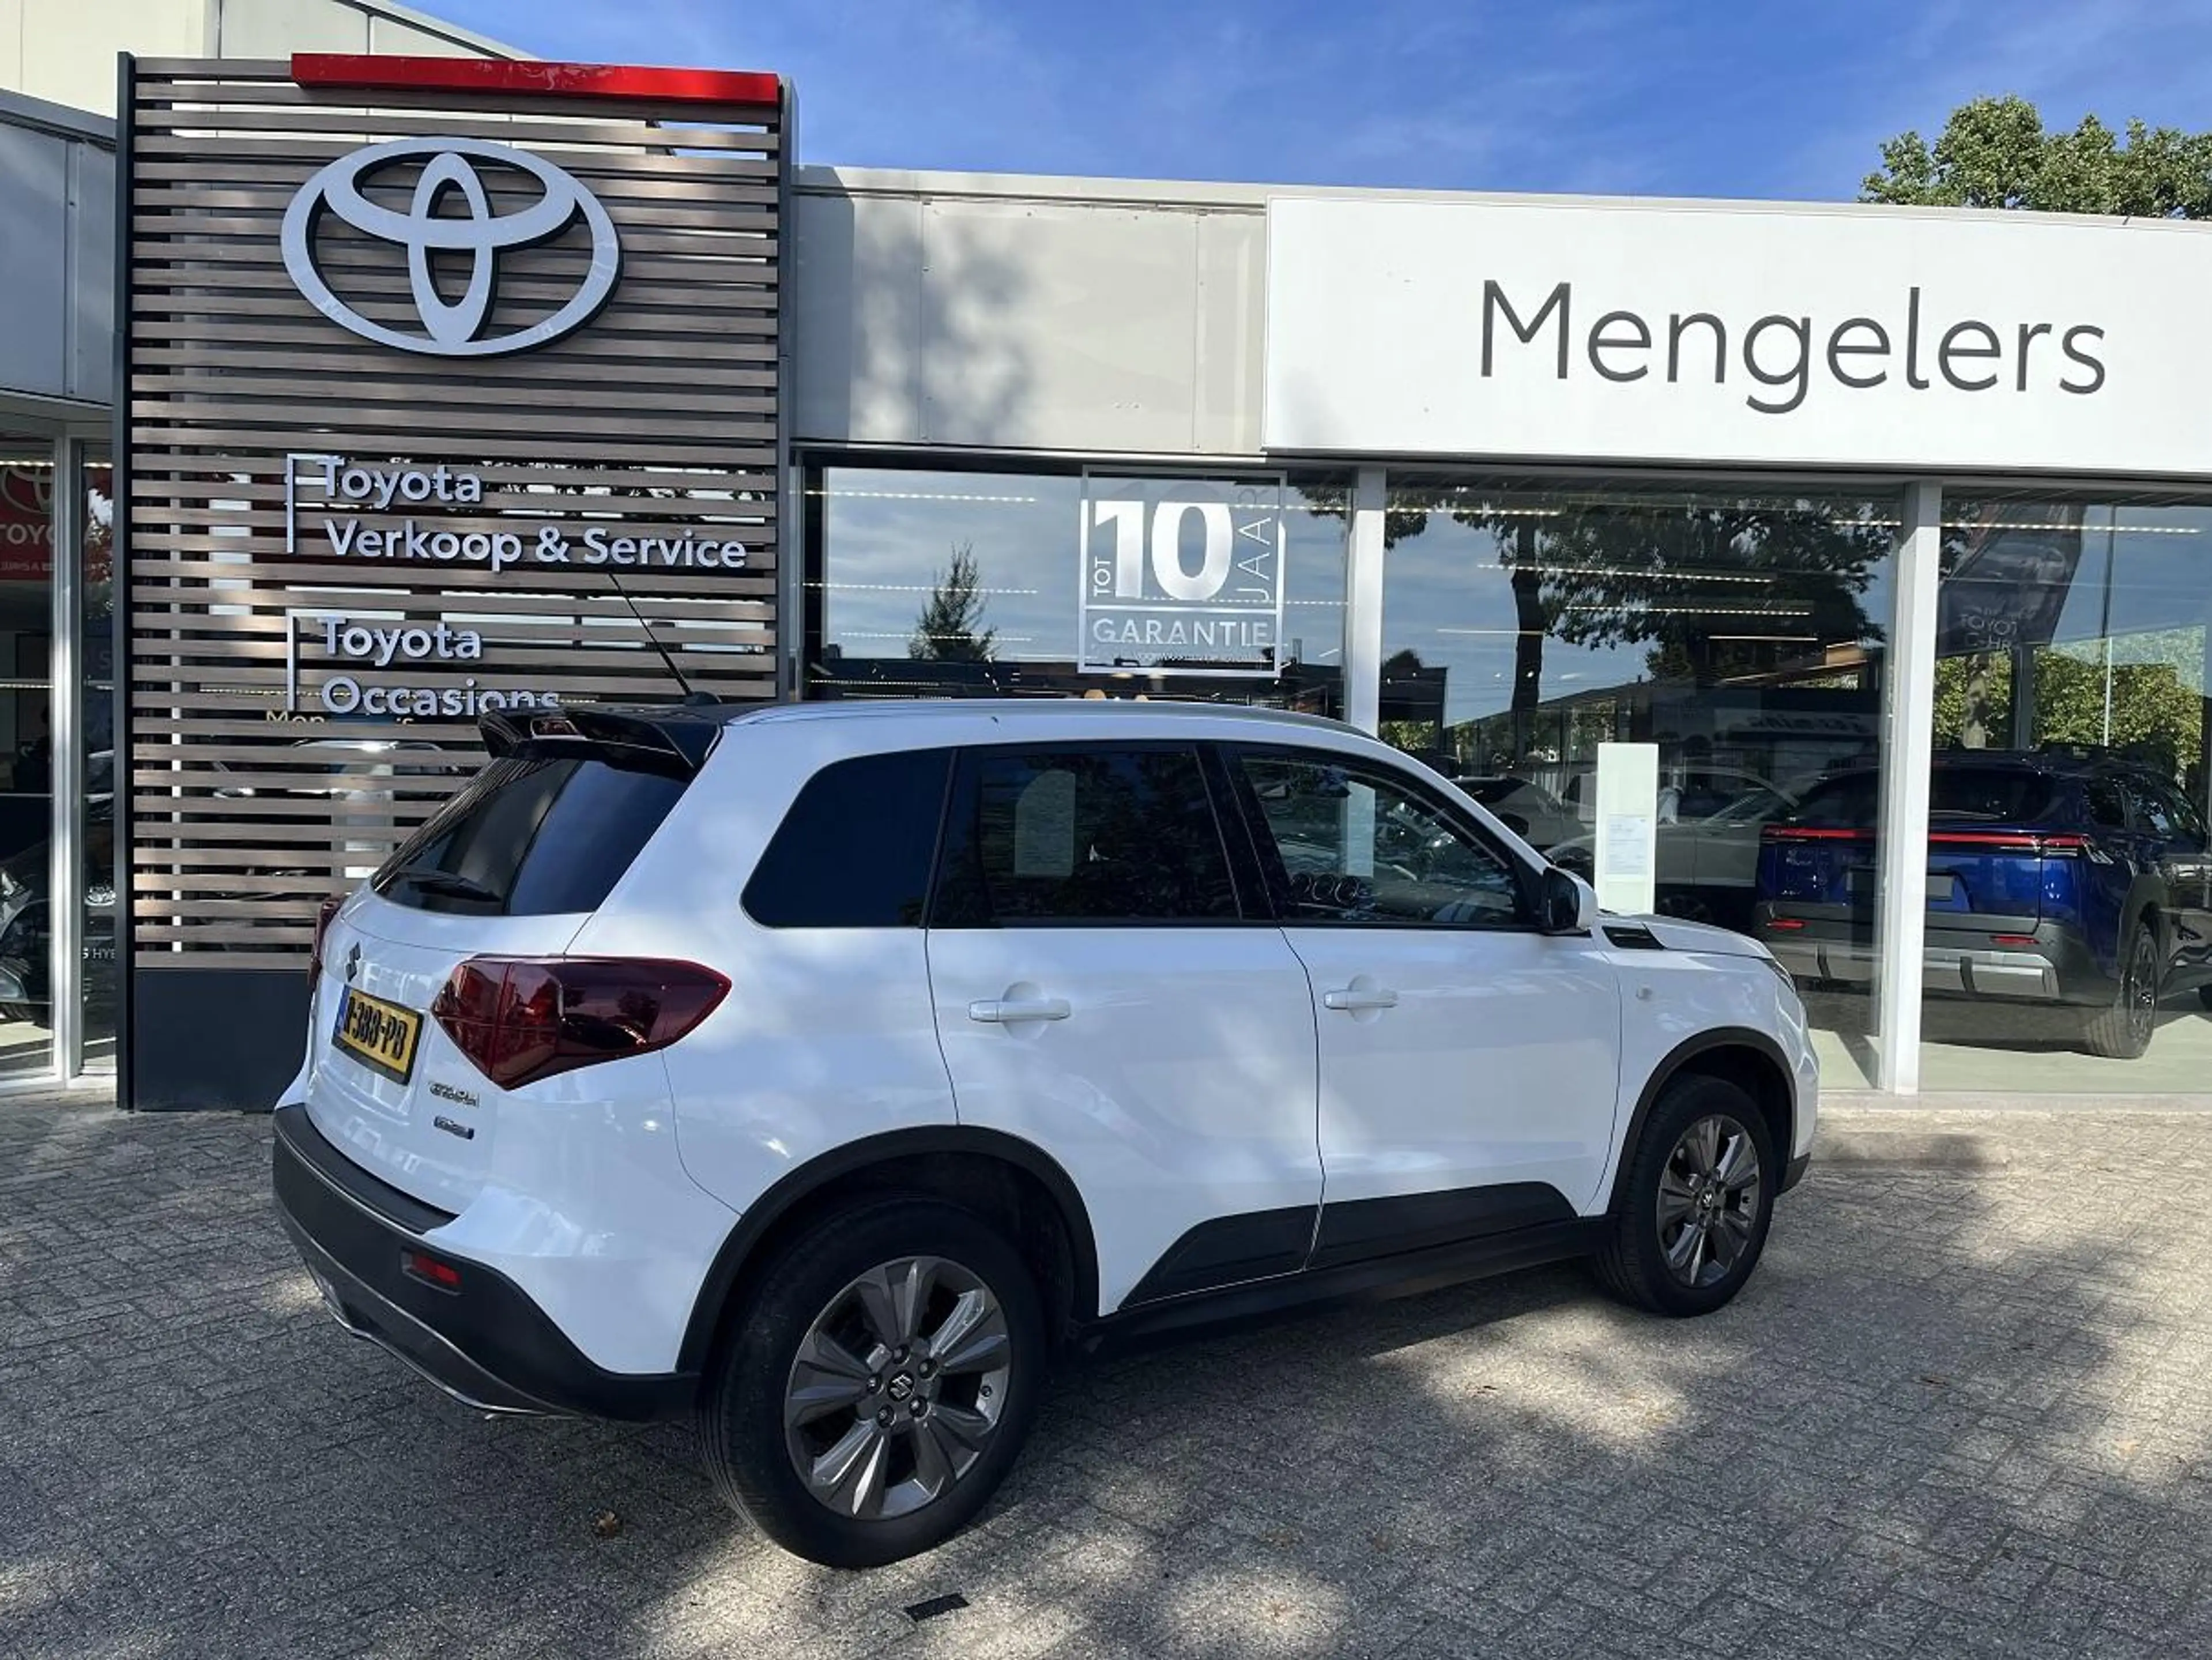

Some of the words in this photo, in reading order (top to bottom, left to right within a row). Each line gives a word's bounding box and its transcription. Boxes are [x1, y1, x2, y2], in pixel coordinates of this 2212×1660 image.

[1481, 280, 2105, 414] Mengelers
[316, 455, 482, 510] Toyota
[324, 518, 523, 572] Verkoop
[535, 526, 570, 563] &
[583, 529, 747, 568] Service
[1094, 482, 1233, 600] 10
[1093, 556, 1111, 598] TOT
[316, 616, 482, 667] Toyota
[1092, 618, 1269, 647] GARANTIE
[322, 676, 559, 716] Occasions
